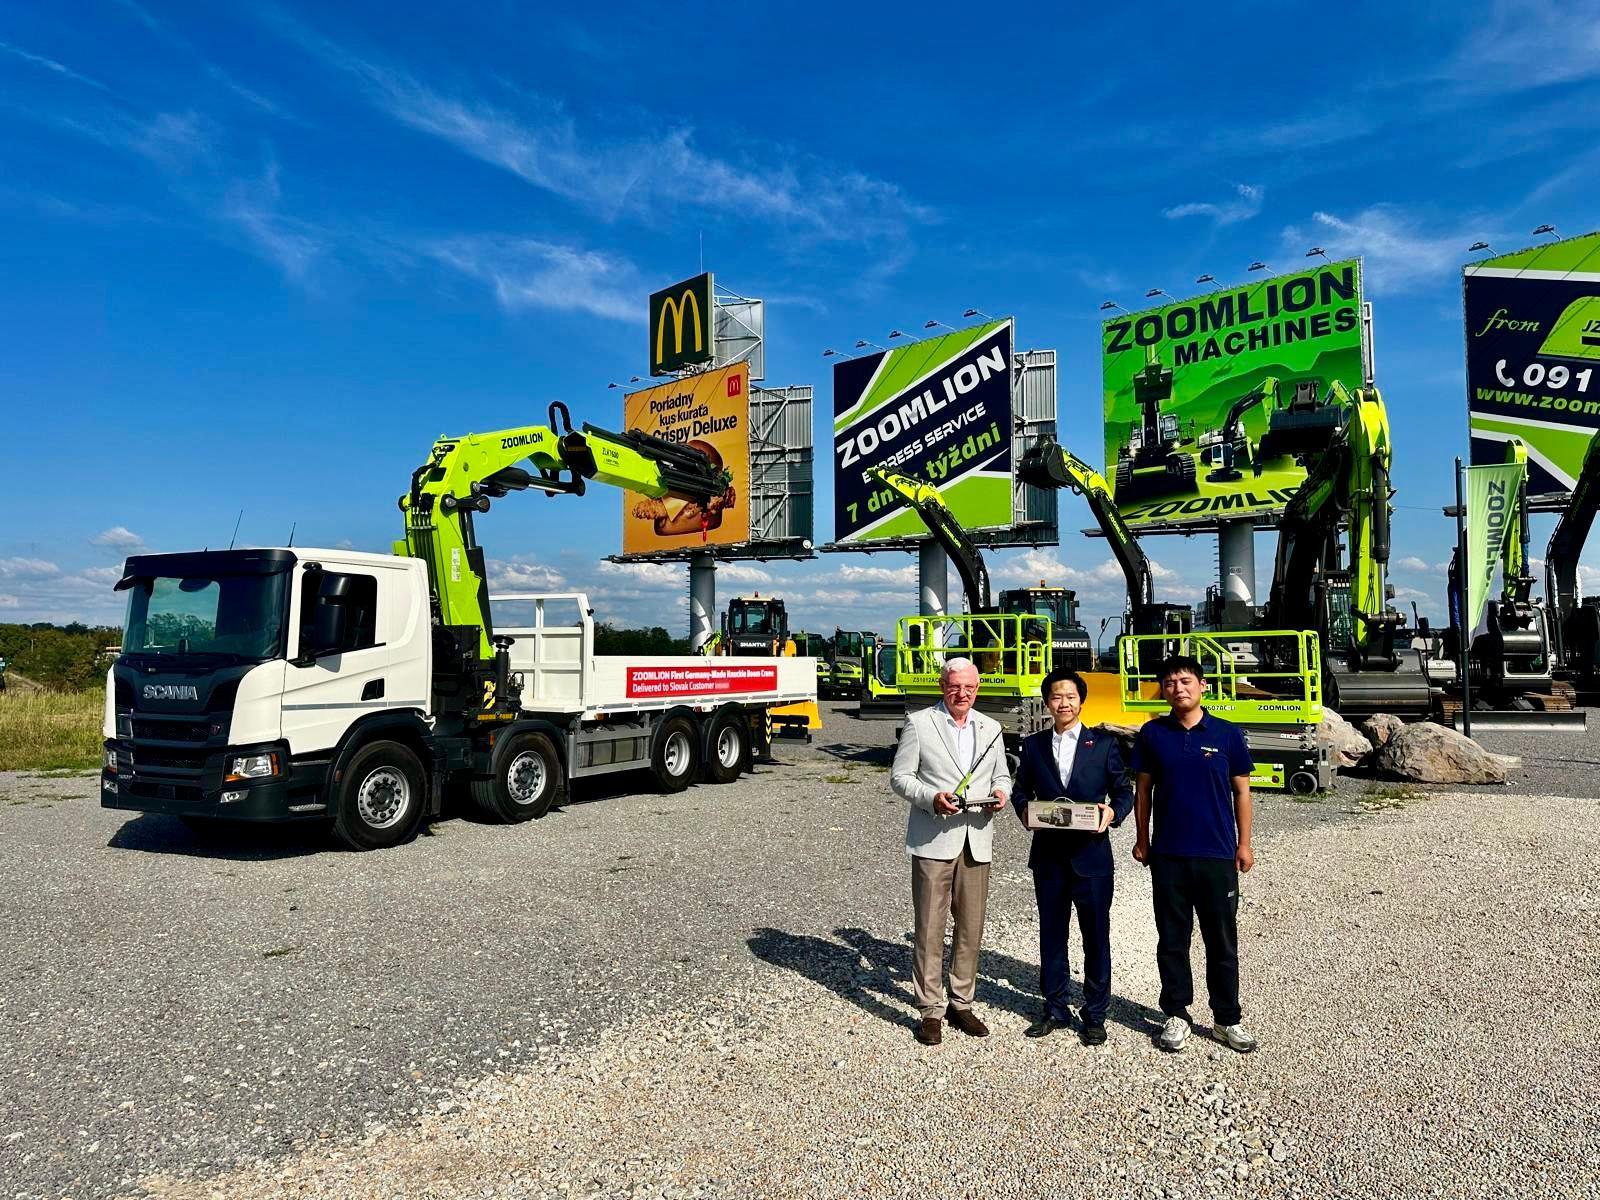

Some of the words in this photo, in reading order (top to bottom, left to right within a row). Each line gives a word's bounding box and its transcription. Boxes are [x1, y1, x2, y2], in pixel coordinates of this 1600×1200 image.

[1105, 266, 1355, 354] ZOOMLION
[1475, 308, 1541, 337] from
[1174, 307, 1358, 367] MACHINES
[1523, 363, 1593, 393] 091
[650, 393, 695, 414] Poriadny
[836, 345, 1007, 470] ZOOMLION
[659, 413, 678, 427] kus
[693, 414, 738, 437] Deluxe
[500, 432, 543, 449] ZOOMLION
[861, 438, 924, 484] EPRESS
[924, 402, 986, 449] SERVICE
[846, 503, 859, 523] 7
[867, 485, 901, 513] dn
[925, 421, 1002, 481] týždni
[1122, 486, 1302, 520] ZOOMLIO
[940, 523, 962, 548] ZOOMLION
[1108, 512, 1127, 544] ZOOMLION
[1485, 479, 1506, 587] ZOOMLI
[632, 671, 670, 680] ZOOMLION
[671, 671, 684, 679] First
[632, 683, 661, 693] Delivered
[663, 683, 669, 691] to
[670, 682, 688, 691] Slovak
[689, 681, 715, 690] Customer
[143, 684, 198, 701] SCANIA
